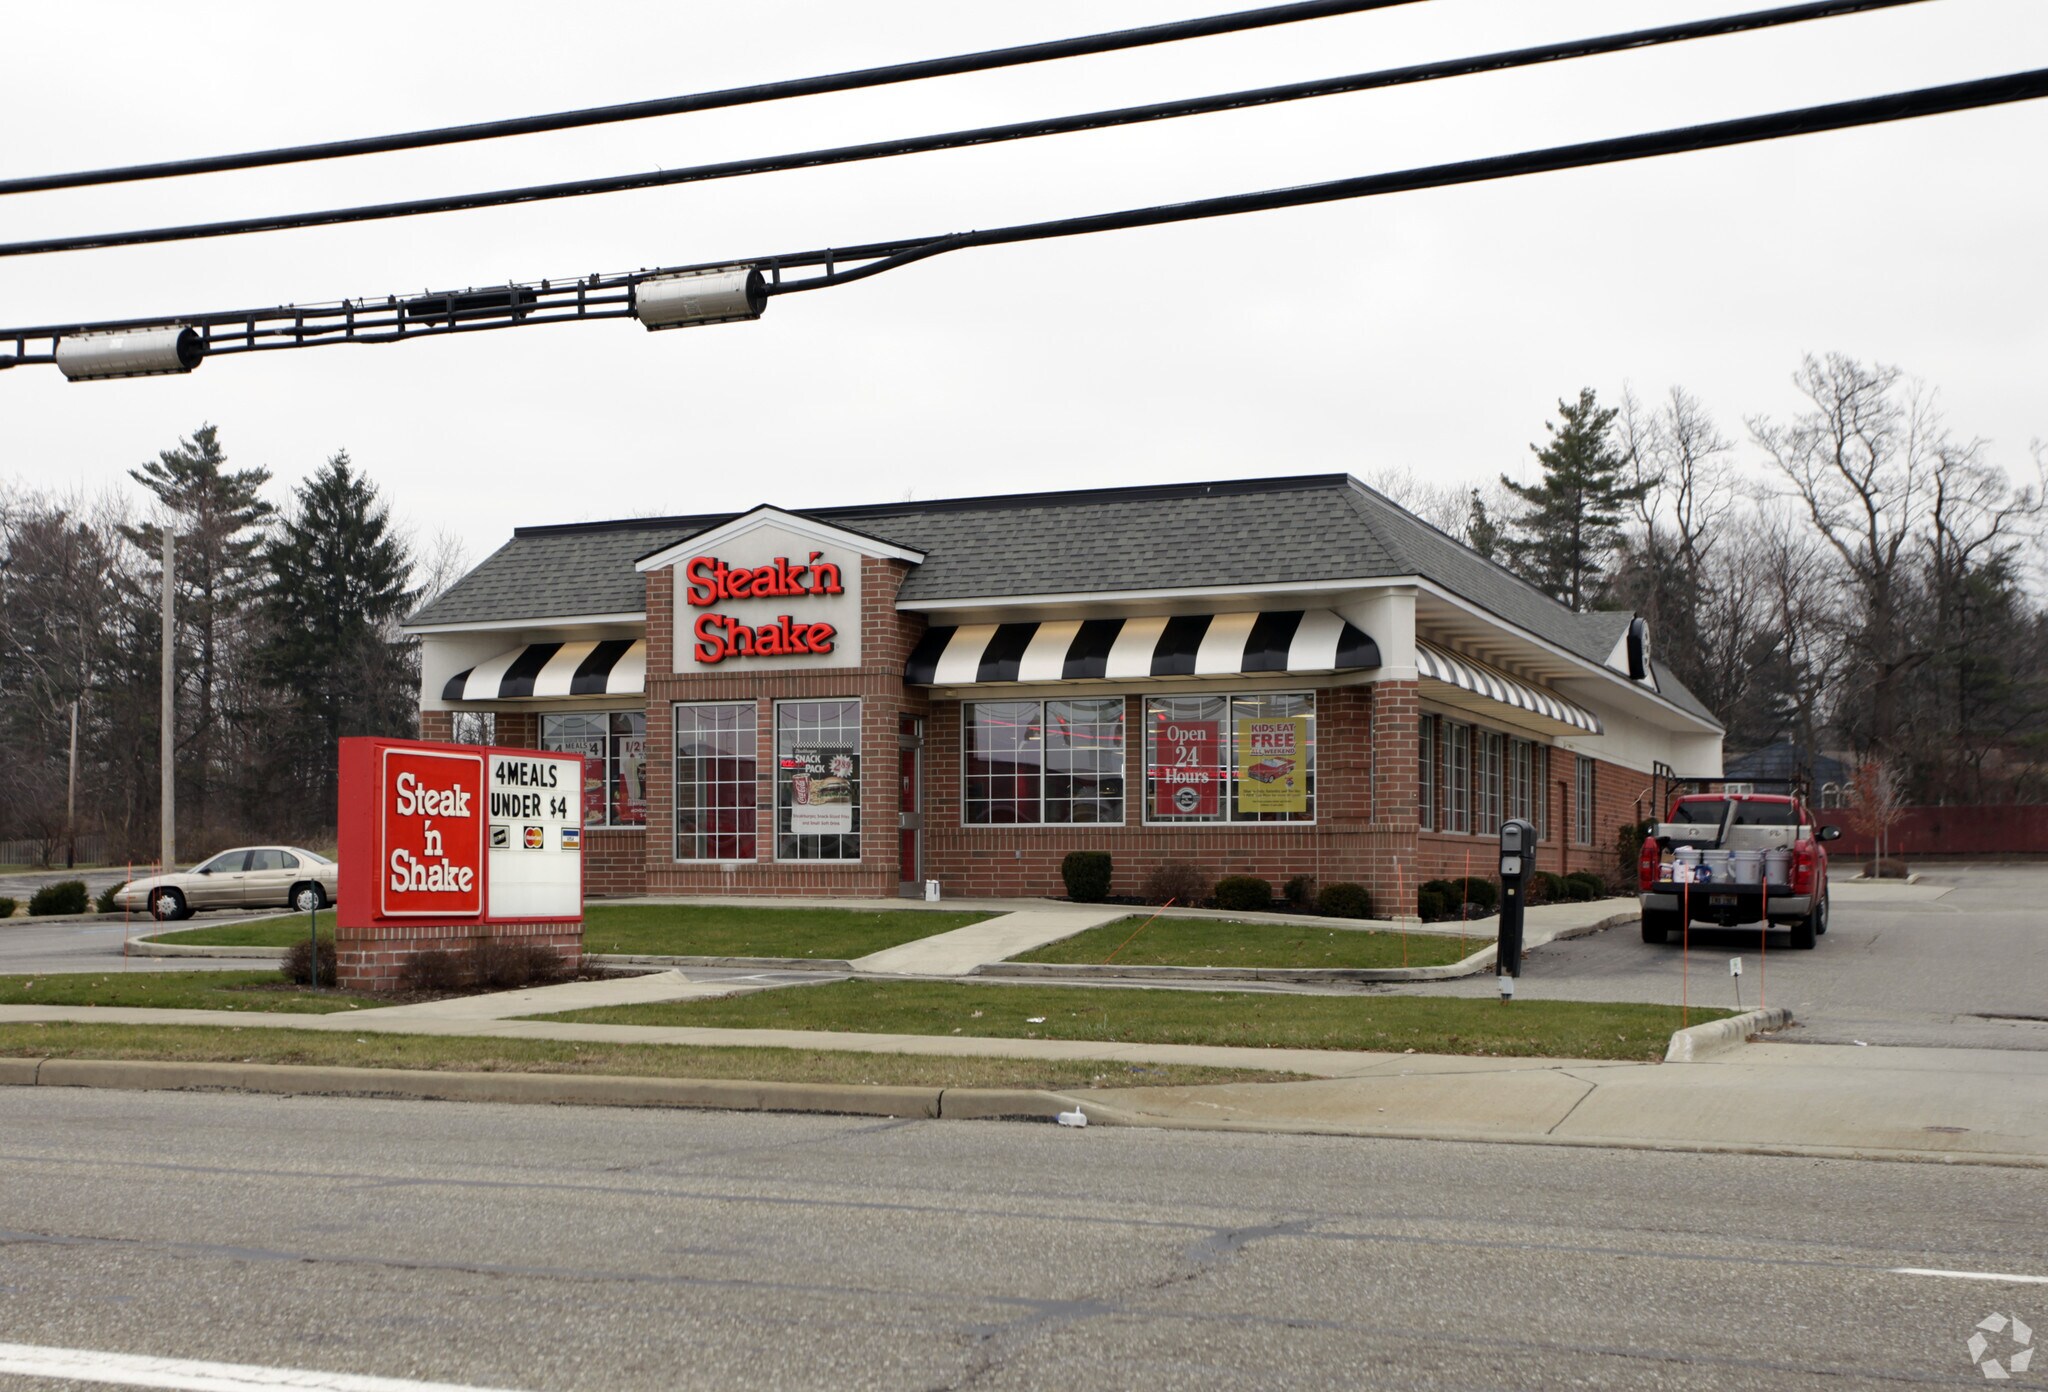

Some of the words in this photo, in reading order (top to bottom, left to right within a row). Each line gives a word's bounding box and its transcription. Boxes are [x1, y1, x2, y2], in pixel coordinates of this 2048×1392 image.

[694, 613, 838, 664] Shake
[1167, 725, 1207, 745] Open
[1251, 724, 1274, 733] KIDS
[1276, 723, 1295, 732] EAT
[1251, 733, 1295, 748] FREE
[795, 754, 821, 764] SNACK
[1175, 746, 1199, 767] 24
[805, 763, 826, 773] PACK
[1165, 767, 1209, 784] Hours
[396, 772, 471, 817] Steak
[491, 792, 542, 818] UNDER
[550, 796, 567, 819] $4
[391, 848, 474, 893] Shake
